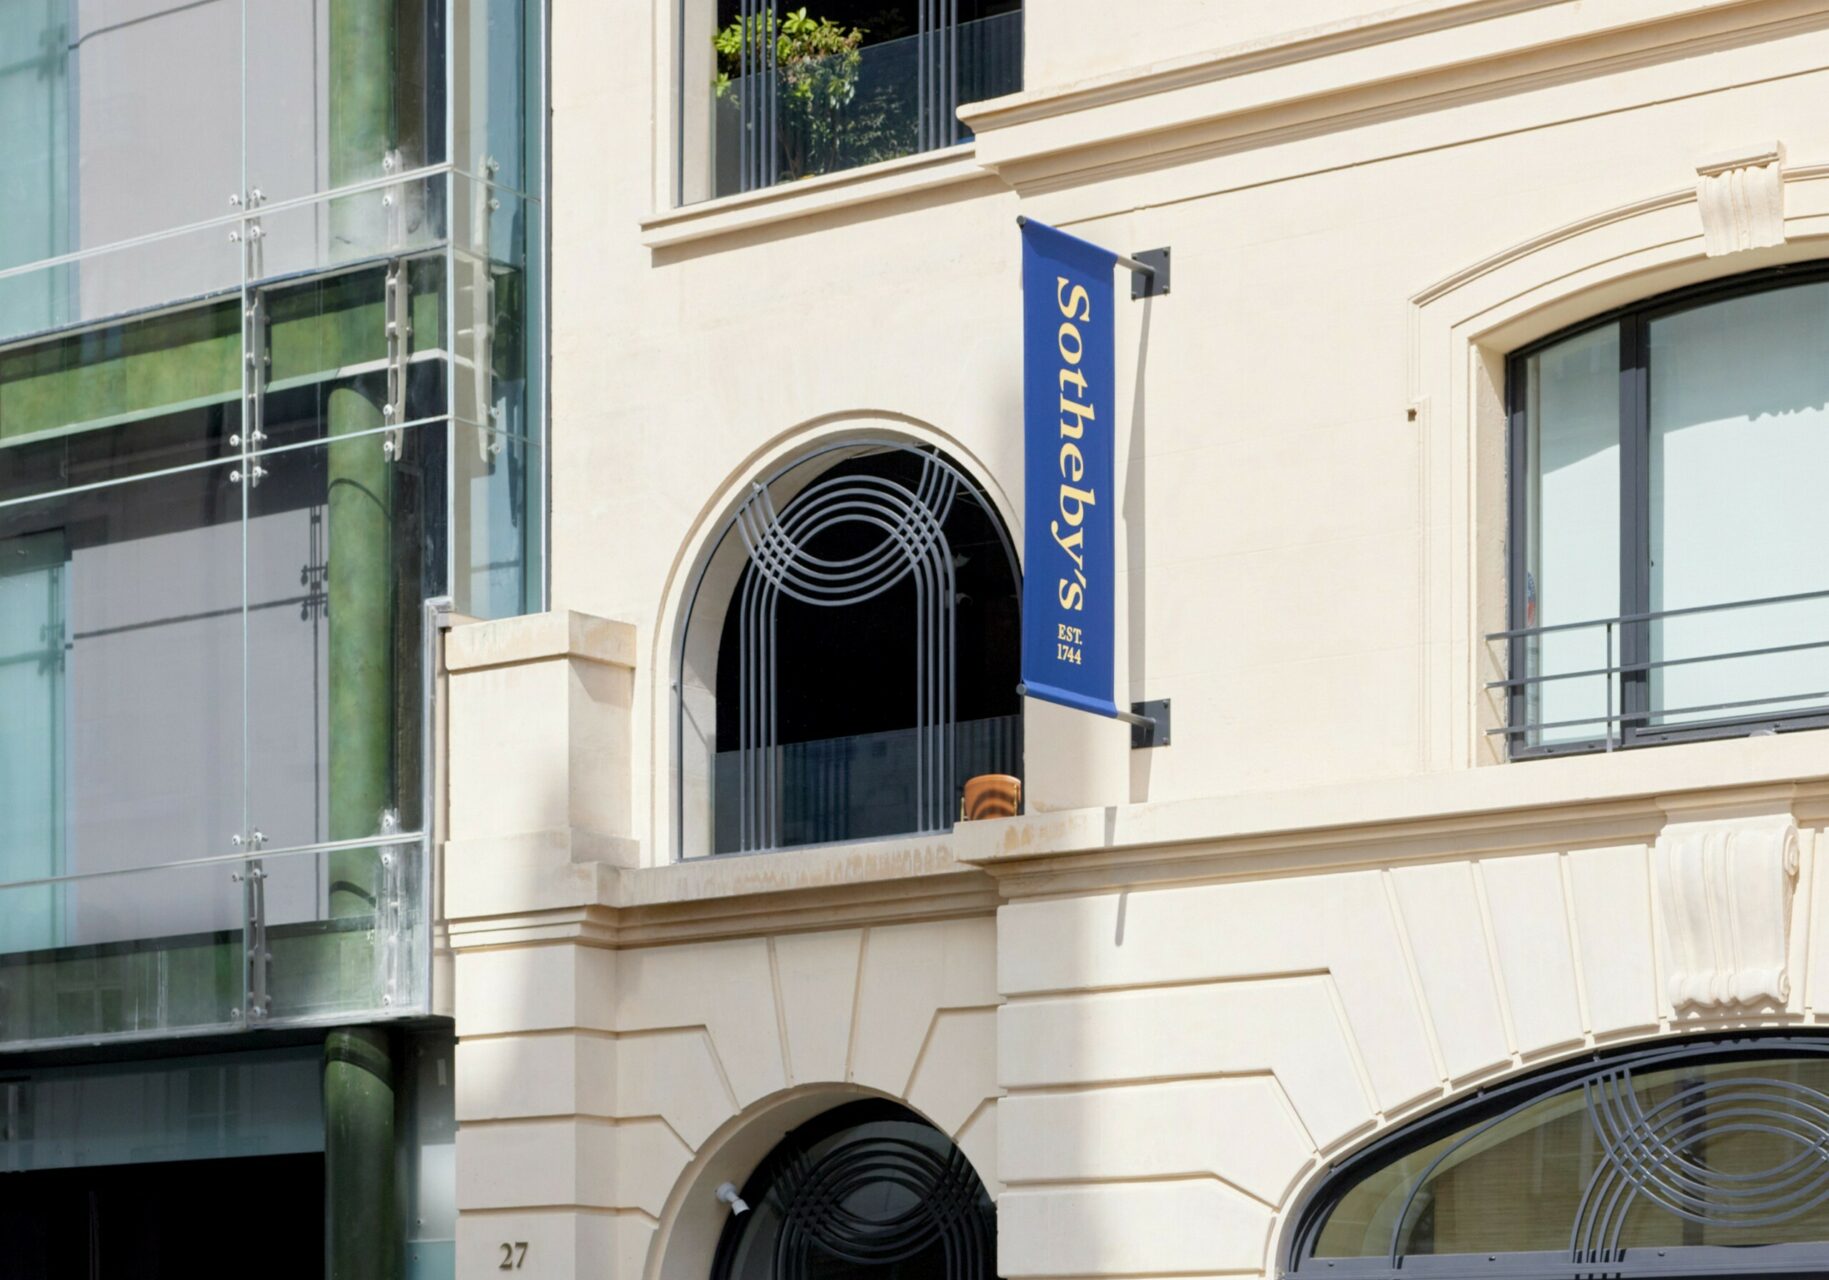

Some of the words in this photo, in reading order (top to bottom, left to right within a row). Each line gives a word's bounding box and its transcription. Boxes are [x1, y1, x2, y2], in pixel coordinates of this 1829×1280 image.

[1051, 276, 1096, 612] Sotheby's
[1057, 623, 1083, 645] EST.
[1057, 643, 1083, 665] 1744
[498, 1241, 529, 1271] 27
